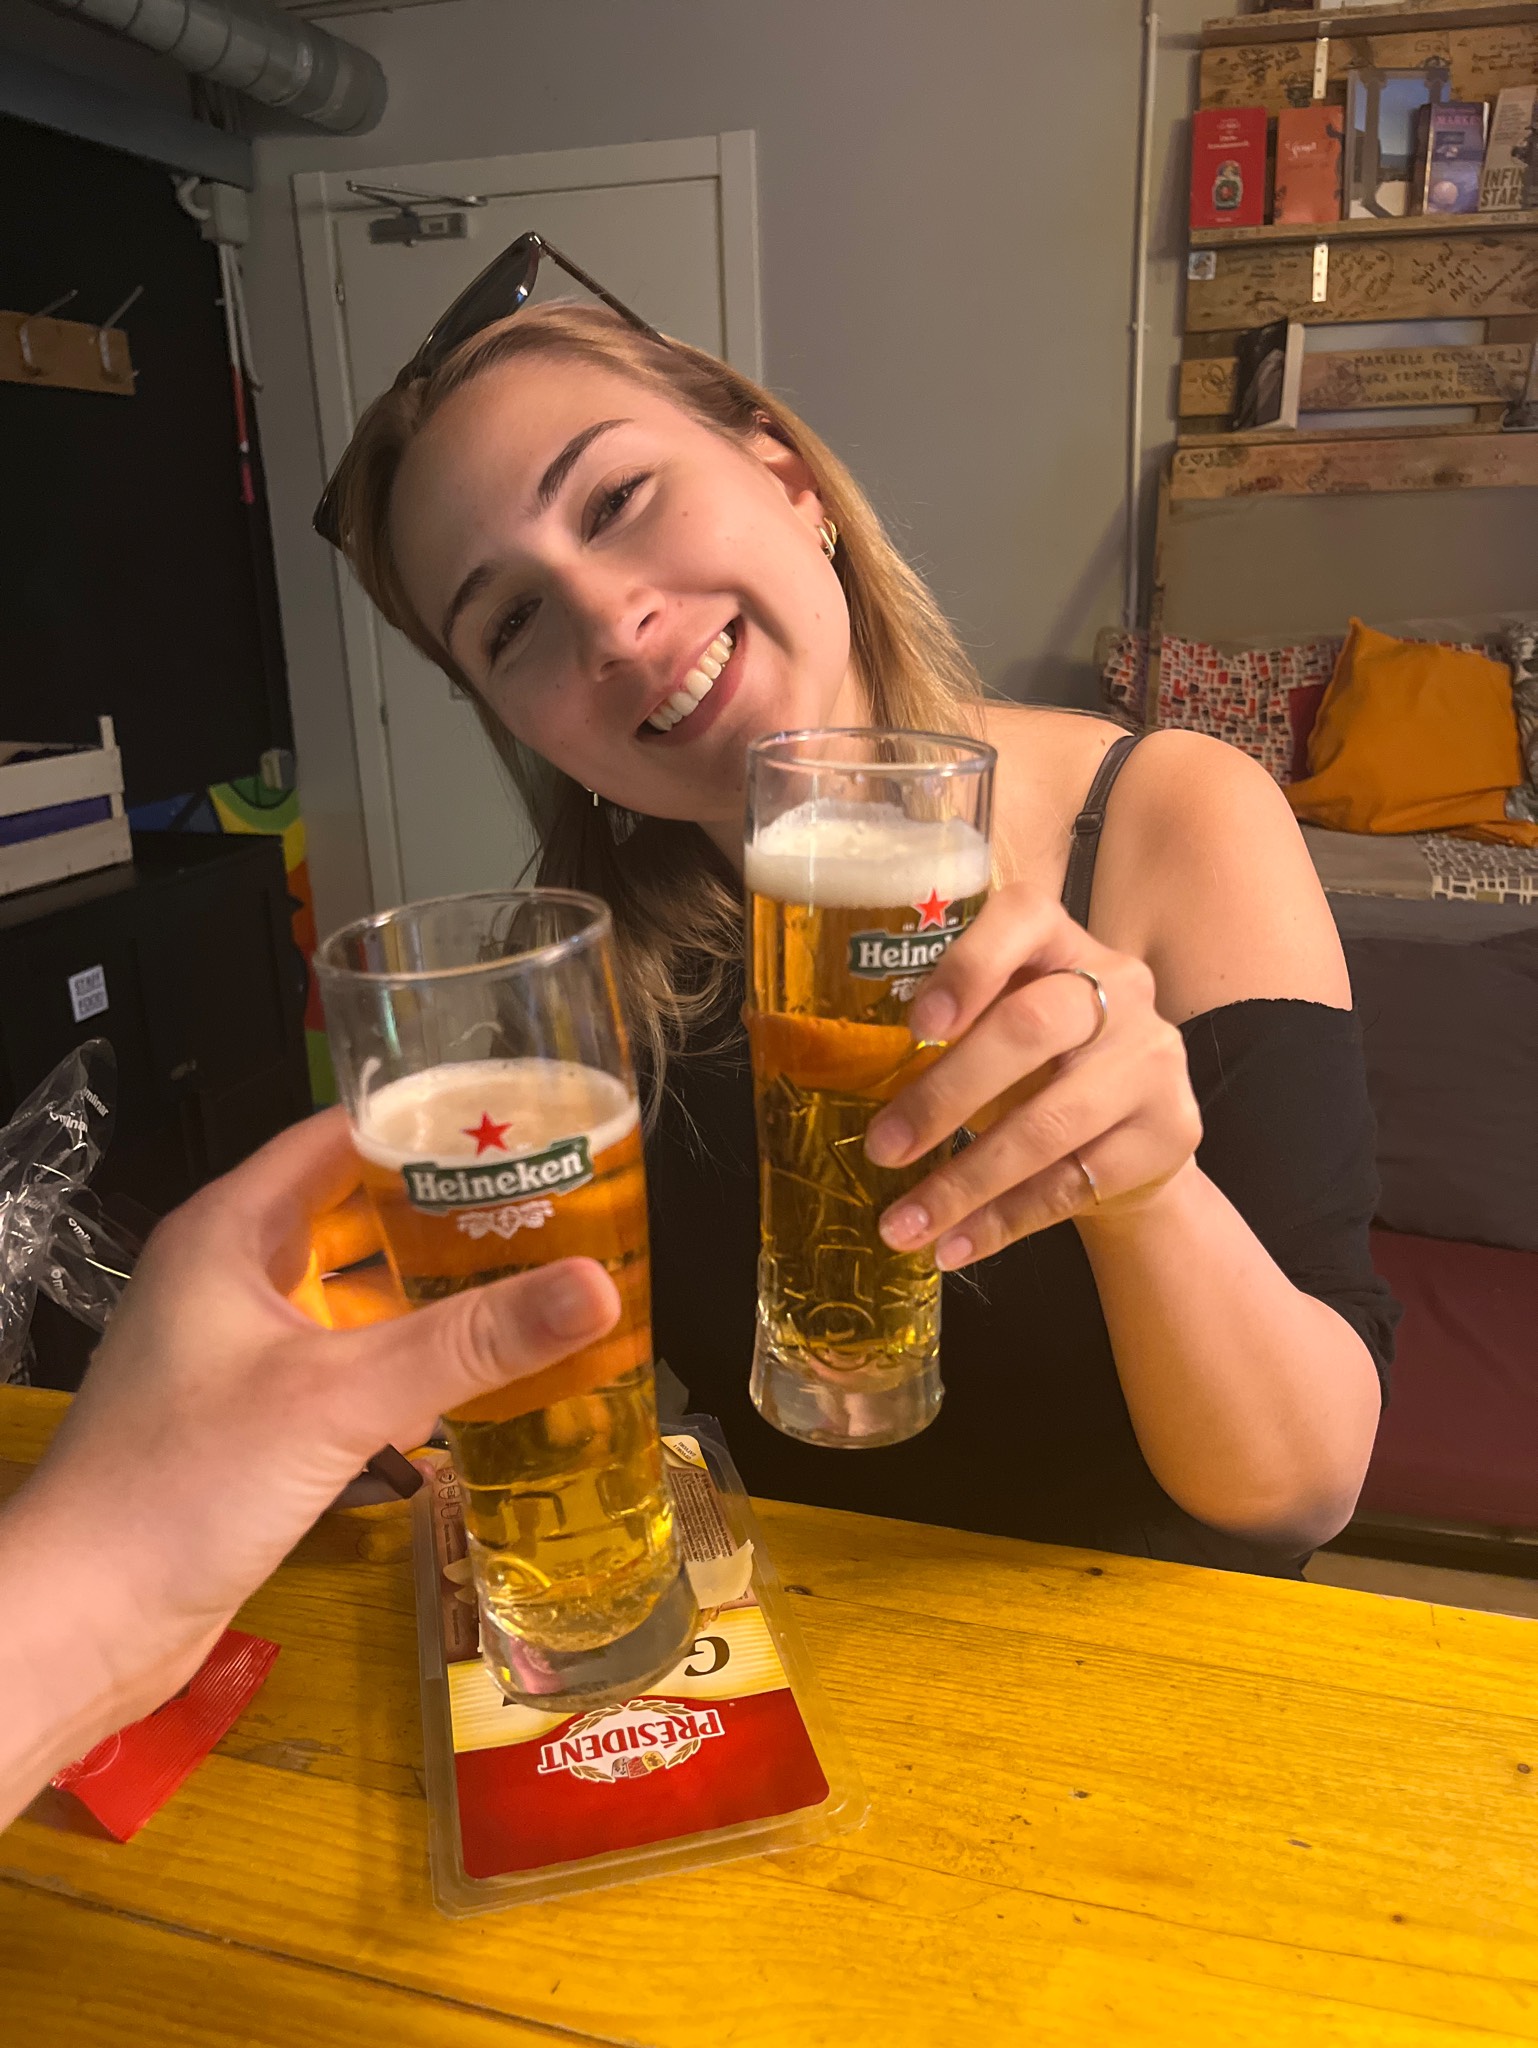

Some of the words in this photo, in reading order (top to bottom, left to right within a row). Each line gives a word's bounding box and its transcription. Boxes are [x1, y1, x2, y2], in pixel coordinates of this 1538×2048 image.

[858, 934, 952, 968] Heine
[411, 1151, 584, 1201] Heineken
[540, 1711, 722, 1771] PRÉSIDENT
